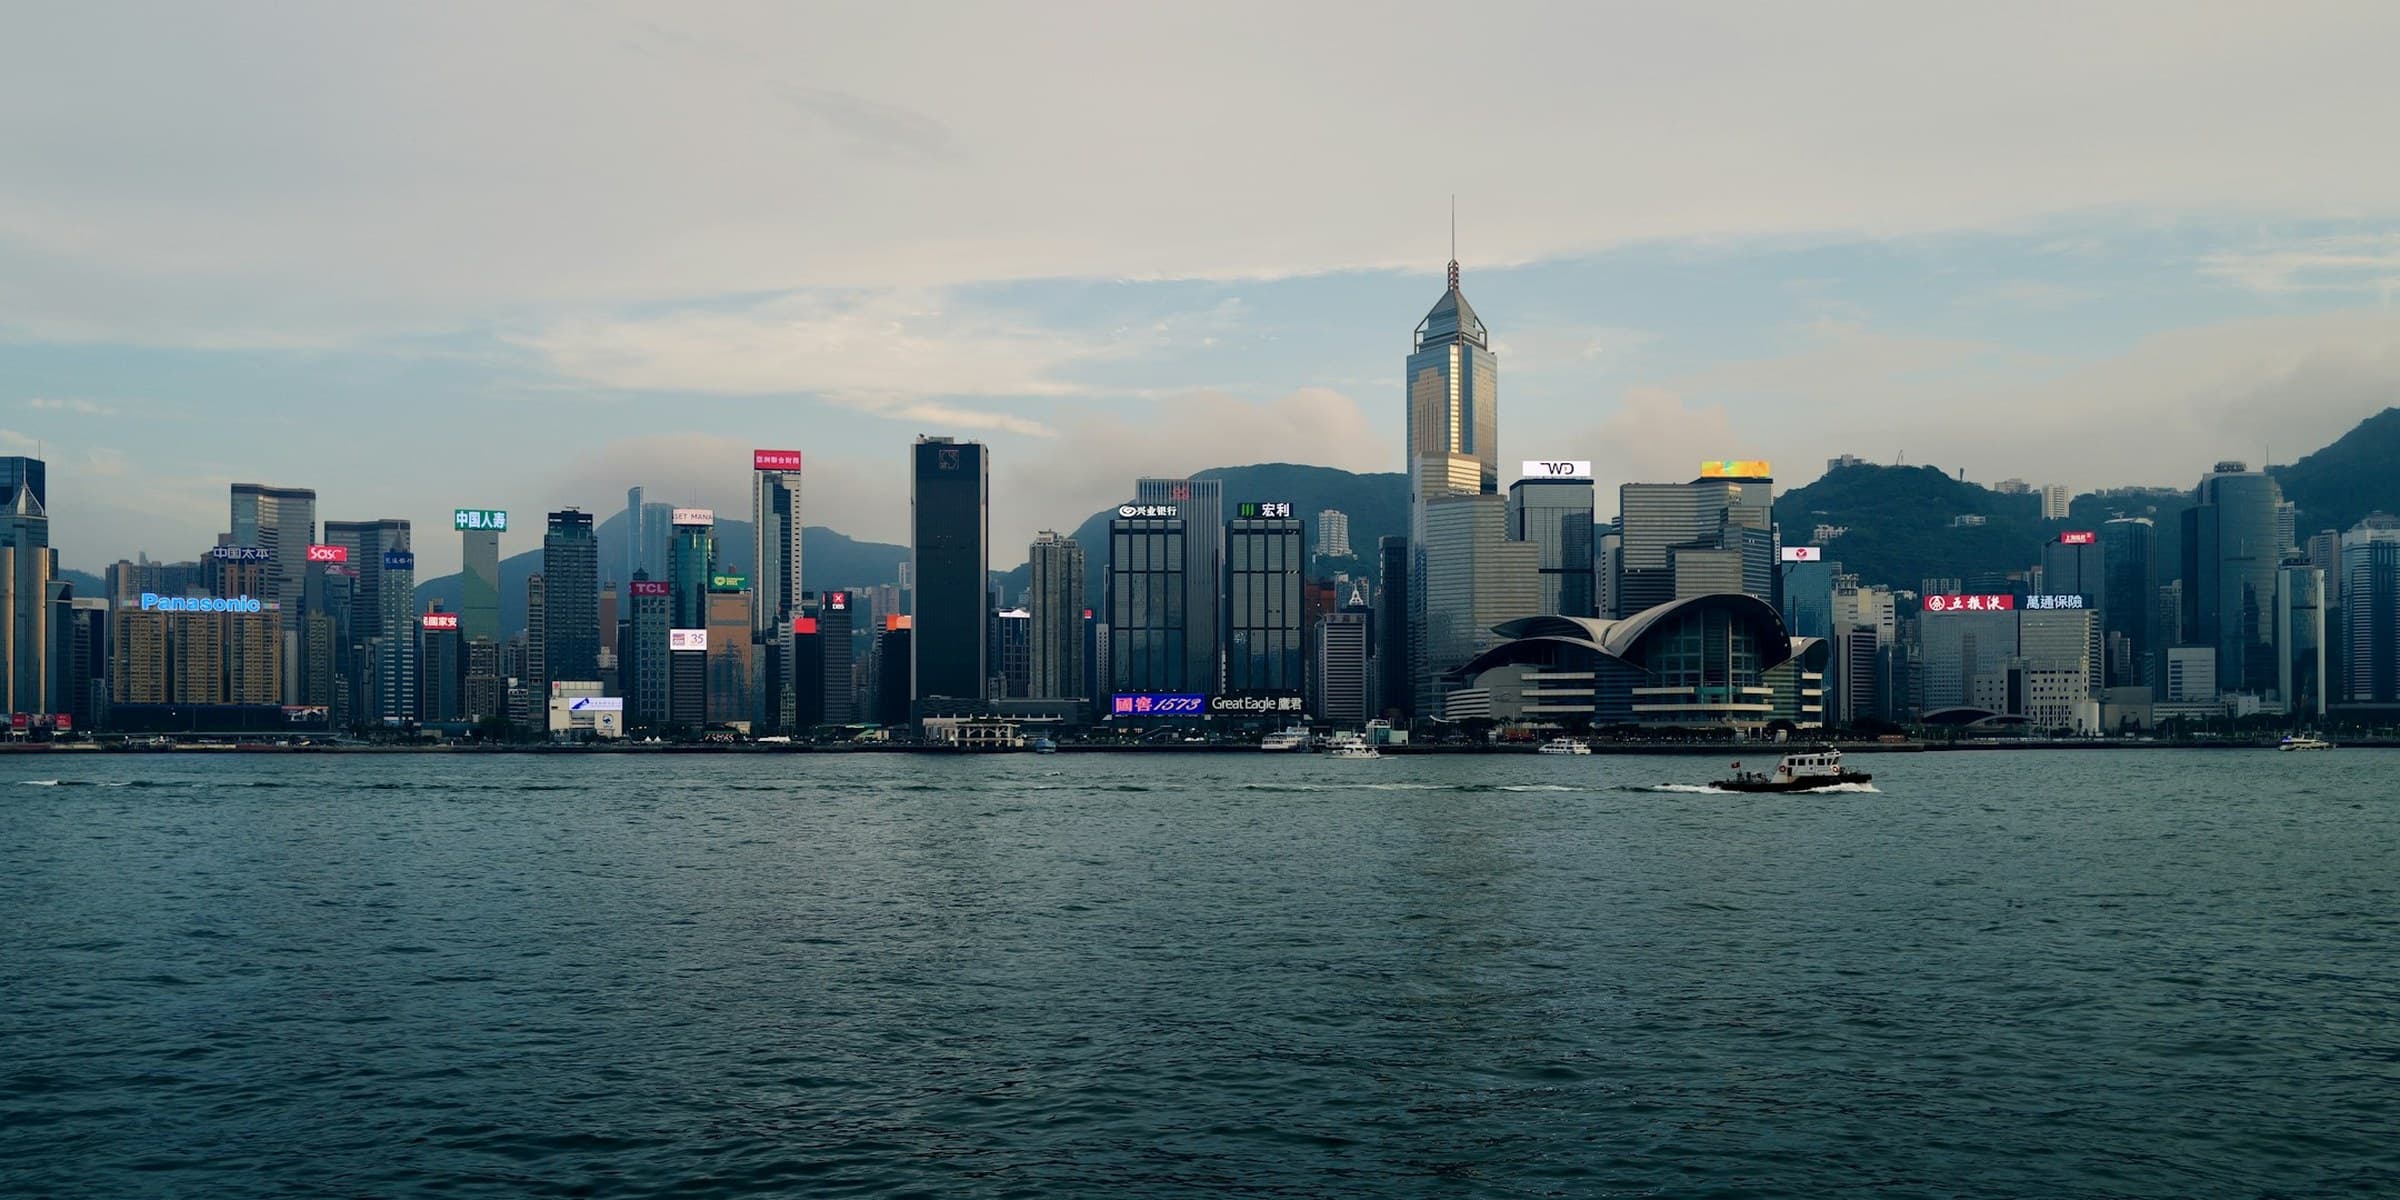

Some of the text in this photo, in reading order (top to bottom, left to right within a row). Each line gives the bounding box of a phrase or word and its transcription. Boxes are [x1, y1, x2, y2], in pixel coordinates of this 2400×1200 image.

[1136, 505, 1177, 516] 兴业银行
[1261, 502, 1290, 518] 宏利
[456, 510, 505, 529] 中国人寿
[635, 583, 665, 593] TCL
[141, 592, 261, 613] Panasonic
[2026, 595, 2083, 609] 萬通保險
[691, 633, 704, 645] 35
[1153, 697, 1201, 711] 1573
[1211, 696, 1303, 713] Great Eagle 鷹君
